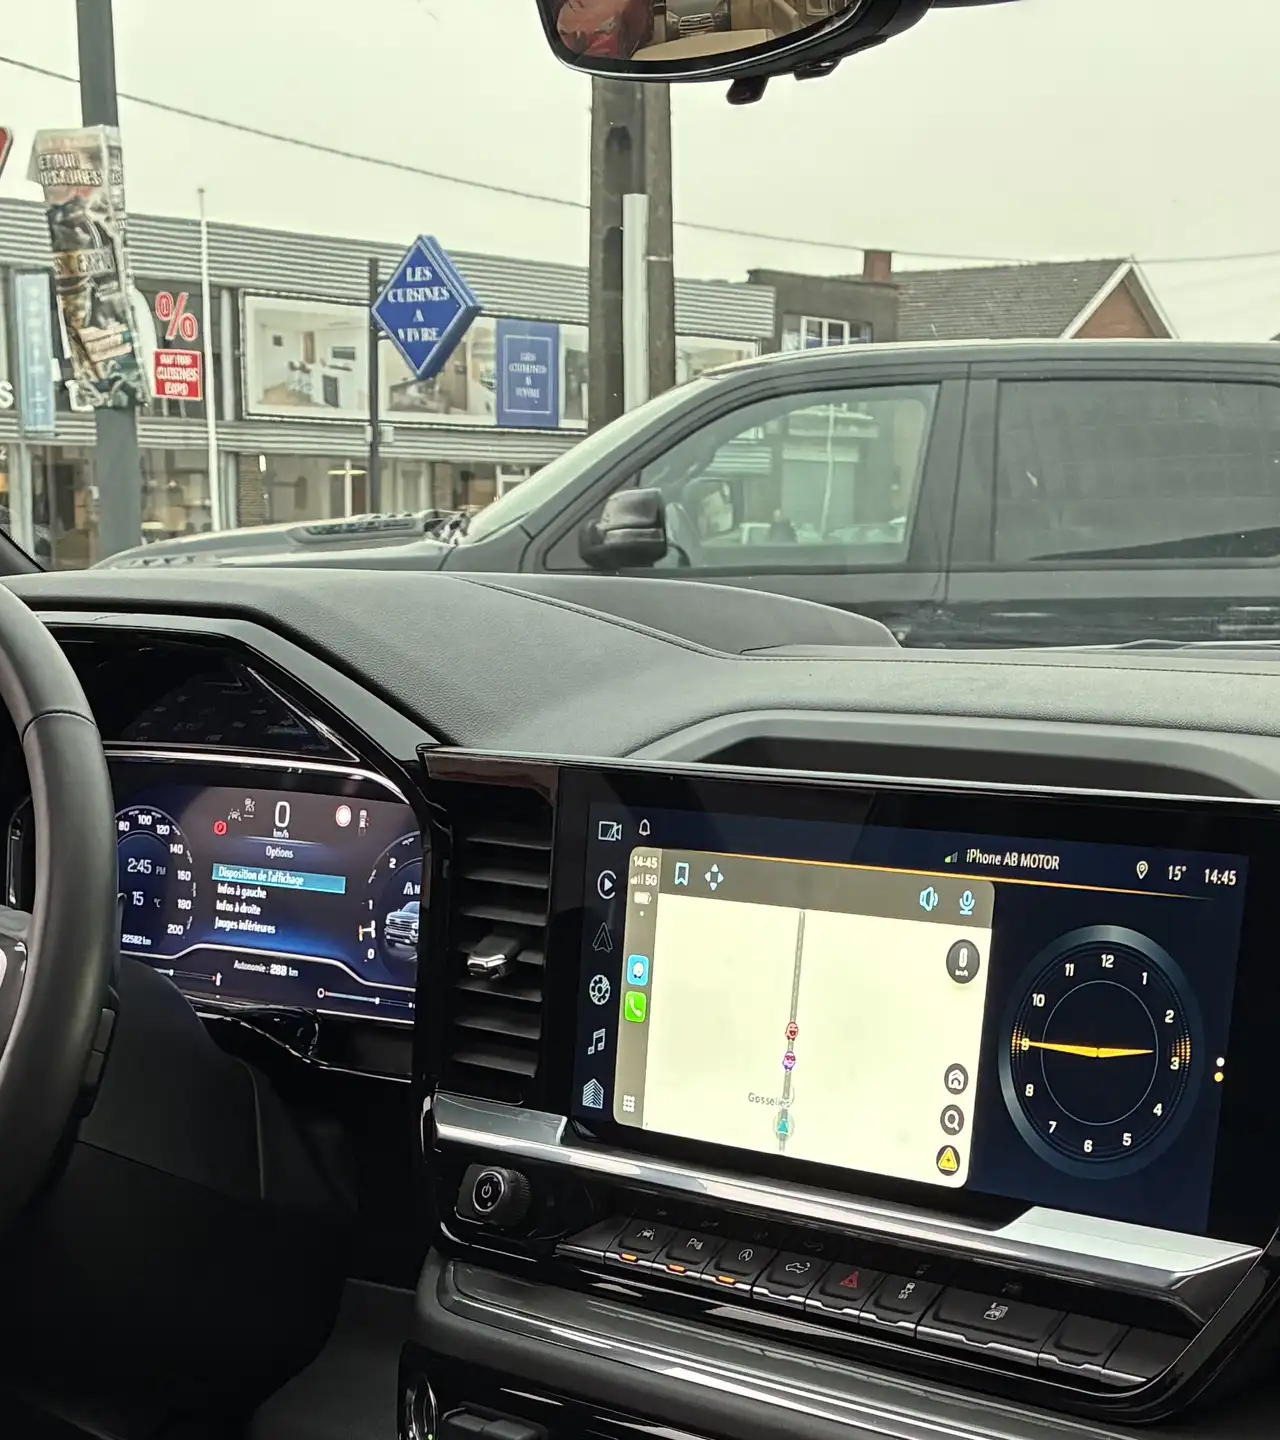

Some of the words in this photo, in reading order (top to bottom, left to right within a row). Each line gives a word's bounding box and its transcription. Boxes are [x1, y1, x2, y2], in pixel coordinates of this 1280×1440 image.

[137, 814, 152, 826] 100
[274, 801, 291, 828] 0
[156, 824, 170, 836] 120
[169, 843, 184, 855] 140
[265, 845, 294, 859] Options
[127, 857, 152, 874] 2:45
[633, 855, 658, 869] 14:45
[966, 849, 1001, 867] iPhone
[1003, 854, 1019, 868] AB
[1020, 855, 1060, 871] MOTOR
[218, 866, 258, 881] Disposition
[1168, 865, 1187, 882] 15°
[1204, 867, 1237, 886] 14:45
[217, 883, 235, 896] Infos
[241, 886, 267, 899] gauche
[131, 891, 145, 906] 15
[216, 899, 234, 912] Infos
[240, 902, 262, 916] droite
[167, 923, 184, 936] 200
[214, 916, 239, 931] Jauges
[238, 920, 277, 934] inférieures
[1101, 954, 1115, 968] 12
[1065, 963, 1075, 977] 11
[1141, 971, 1148, 985] 1
[1032, 993, 1045, 1007] 10
[1165, 1009, 1174, 1023] 2
[1170, 1056, 1179, 1070] 3
[1025, 1084, 1034, 1097] 8
[1153, 1103, 1163, 1117] 4
[1048, 1120, 1057, 1134] 7
[1083, 1139, 1093, 1153] 6
[1122, 1132, 1132, 1146] 5
